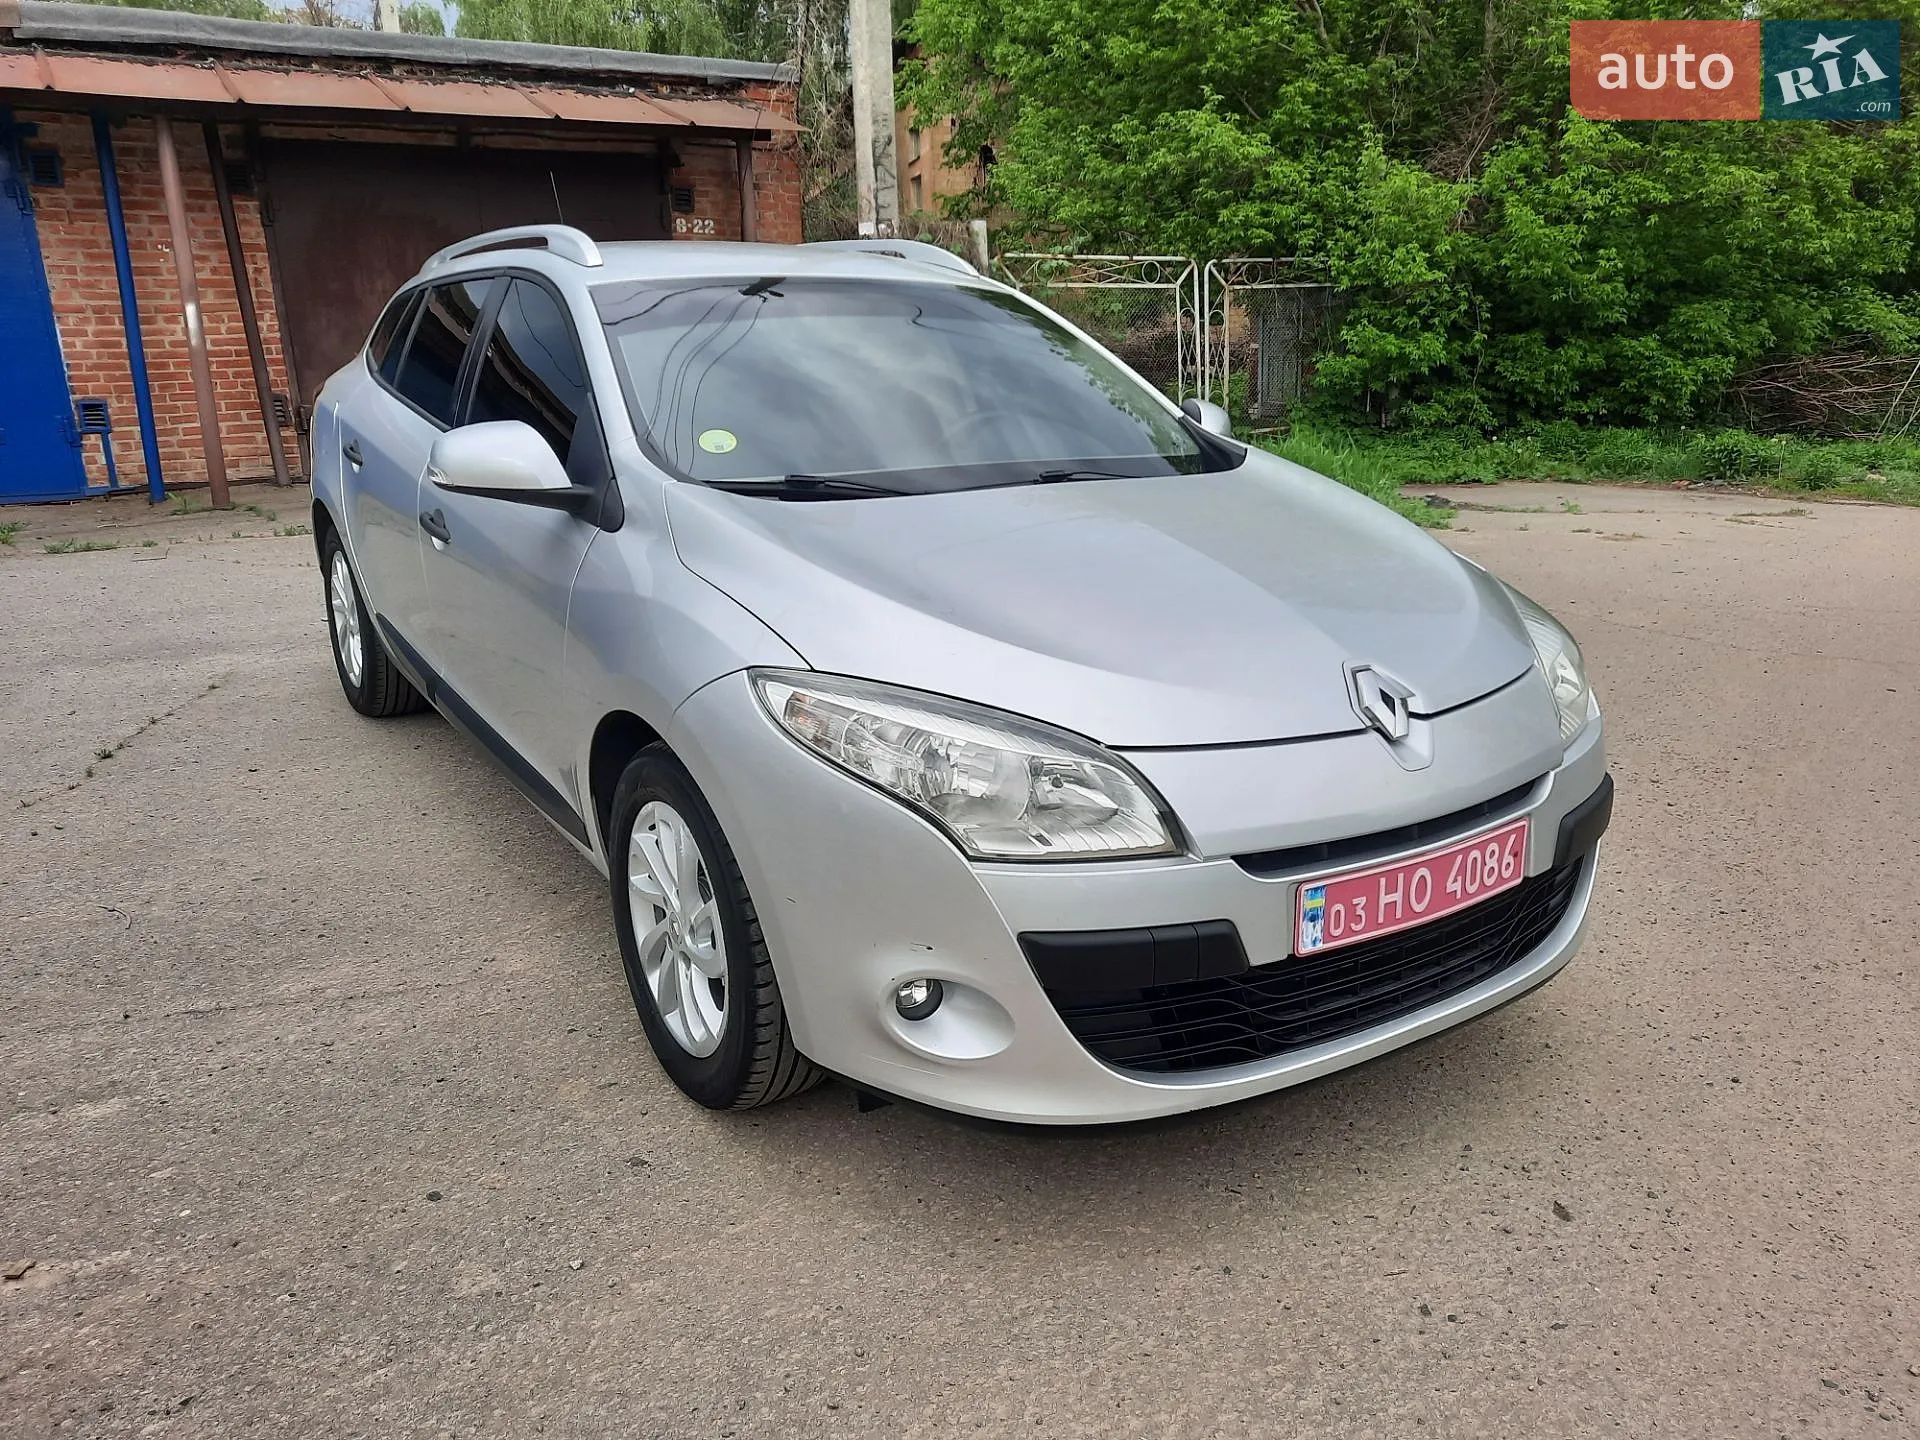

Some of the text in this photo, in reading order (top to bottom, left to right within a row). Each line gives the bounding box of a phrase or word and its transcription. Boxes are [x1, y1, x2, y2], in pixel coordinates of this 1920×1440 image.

[1329, 833, 1517, 937] 03 HO 4086
